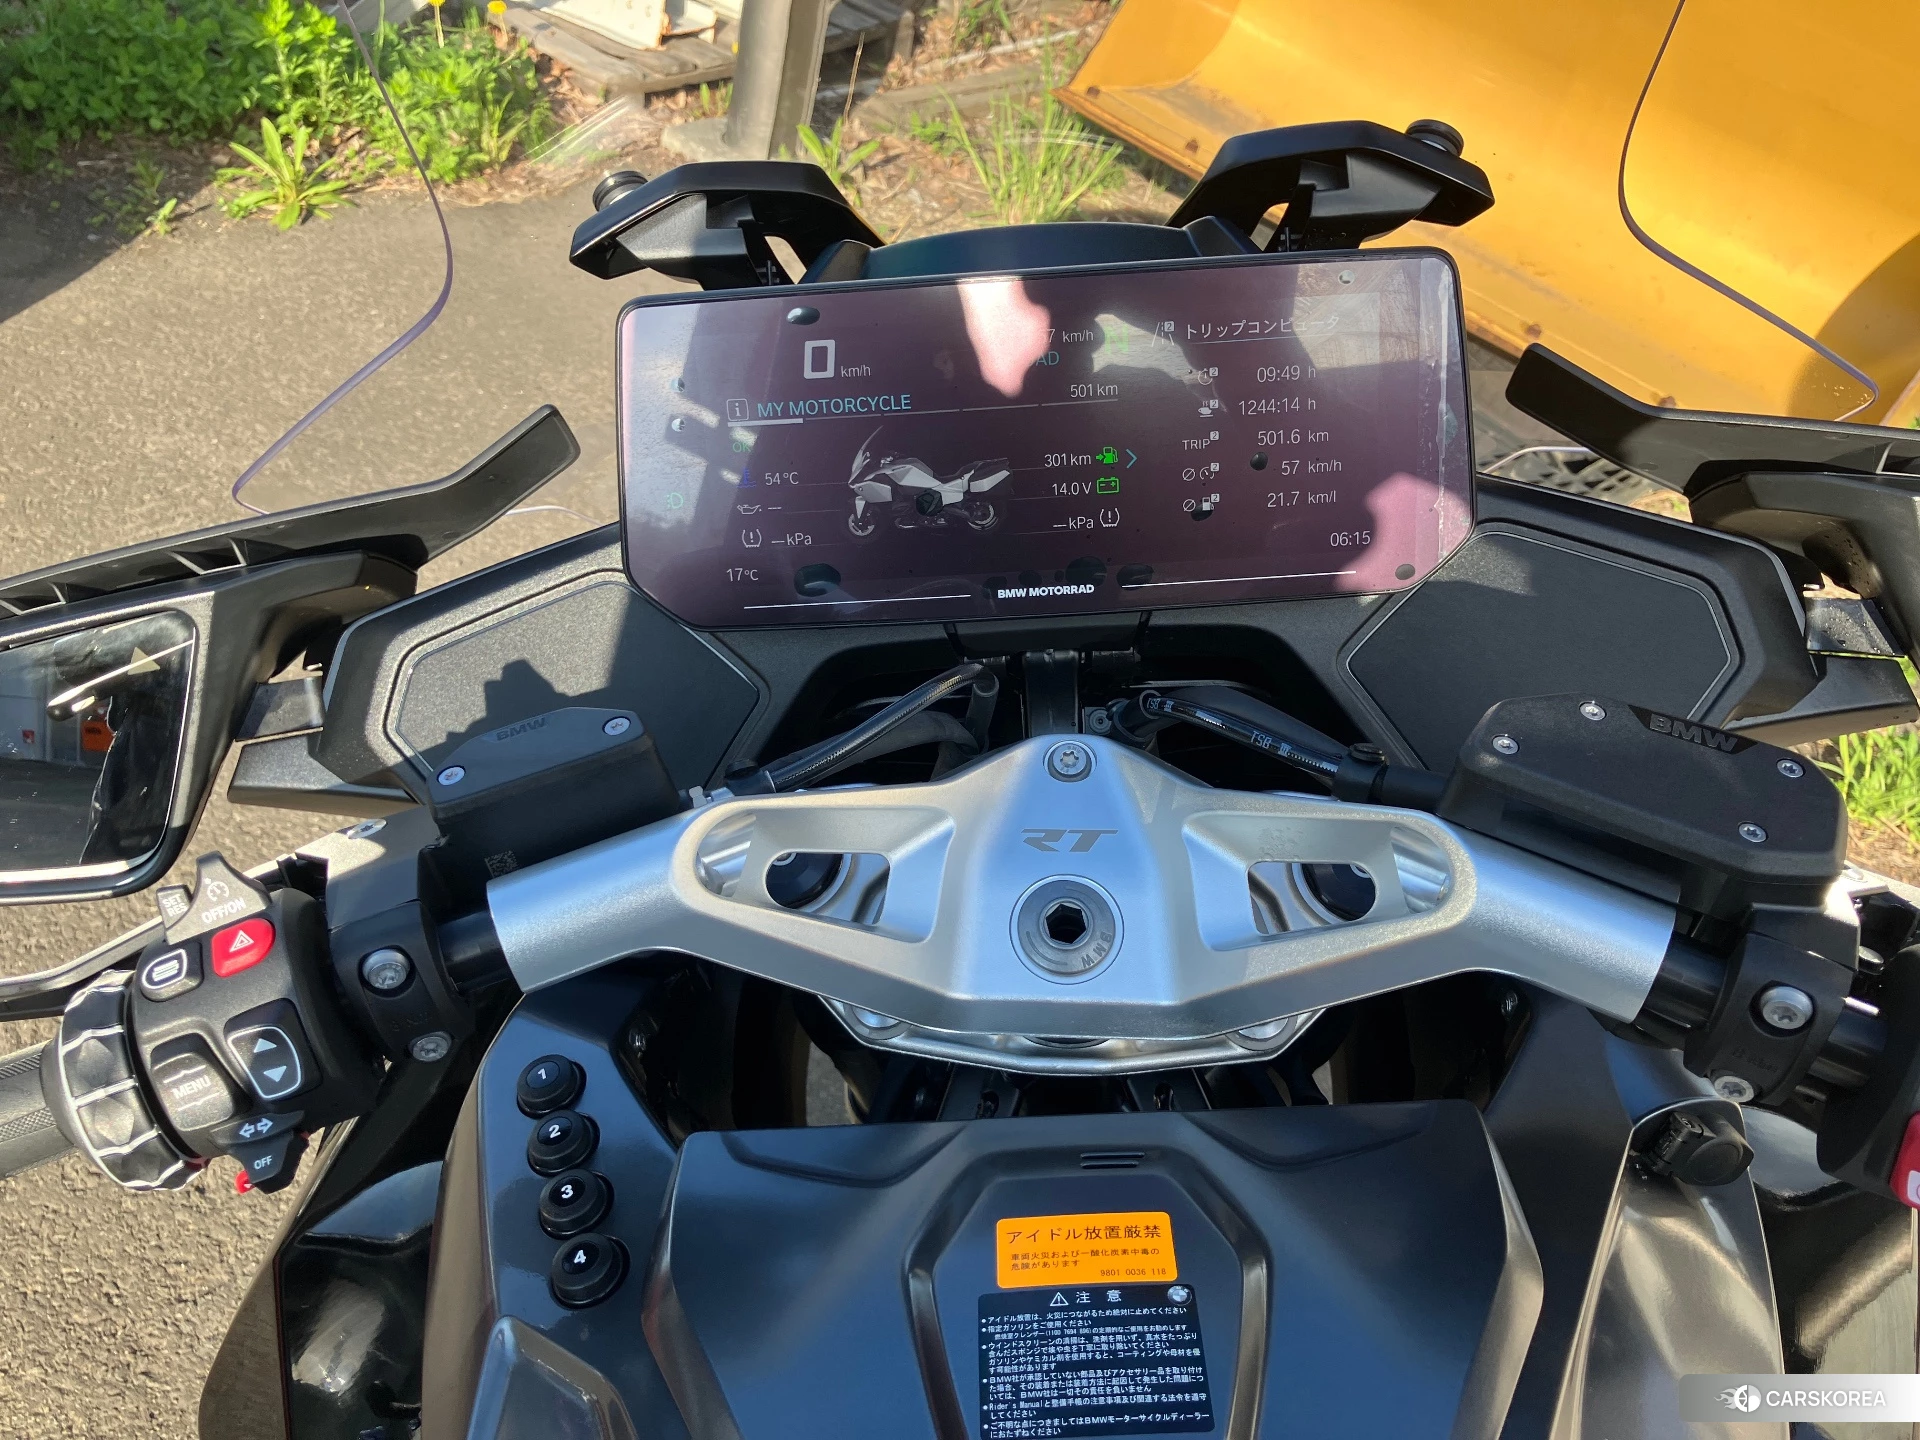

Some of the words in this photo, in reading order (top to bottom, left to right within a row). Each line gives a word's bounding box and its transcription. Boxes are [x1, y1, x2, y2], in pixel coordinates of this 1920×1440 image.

[1186, 315, 1340, 340] トリップコンピュータ
[1062, 330, 1094, 343] km/h
[1104, 327, 1129, 352] N
[803, 339, 836, 380] 0
[840, 364, 872, 378] km/h
[1256, 365, 1301, 383] 09:49
[1308, 365, 1316, 378] h
[1070, 384, 1093, 399] 501
[1096, 383, 1119, 397] km
[757, 401, 784, 418] MY
[788, 394, 912, 416] MOTORCYCLE
[1238, 397, 1300, 416] 1244:14
[1308, 398, 1316, 410] h
[1181, 438, 1211, 450] TRIP
[1257, 429, 1301, 446] 501.6
[1308, 429, 1329, 443] km
[732, 441, 752, 453] OK
[1044, 453, 1067, 468] 301
[1070, 453, 1092, 466] km
[1281, 460, 1300, 475] 57
[1308, 459, 1342, 474] km/h
[1052, 482, 1080, 496] 14.0
[1082, 481, 1092, 495] V
[1267, 491, 1300, 508] 21.7
[1308, 490, 1337, 504] km/l
[1330, 530, 1371, 547] 06:15
[726, 567, 759, 582] 17°C
[997, 587, 1027, 599] BMW
[1028, 584, 1095, 597] MOTORRAD
[496, 717, 546, 741] BMW
[1650, 712, 1738, 752] BMW
[1020, 828, 1119, 853] RT
[162, 894, 182, 908] SET
[166, 902, 188, 917] RES
[201, 897, 247, 924] OFF/ON
[1081, 931, 1113, 969] BMW
[538, 1068, 547, 1080] 1
[172, 1075, 212, 1100] MENU
[549, 1124, 561, 1139] 2
[254, 1155, 273, 1170] OFF
[560, 1184, 574, 1199] 3
[1006, 1224, 1161, 1244] アイドル放置厳禁
[574, 1249, 587, 1265] 4
[1100, 1269, 1120, 1277] 9801
[1125, 1268, 1147, 1276] 0036
